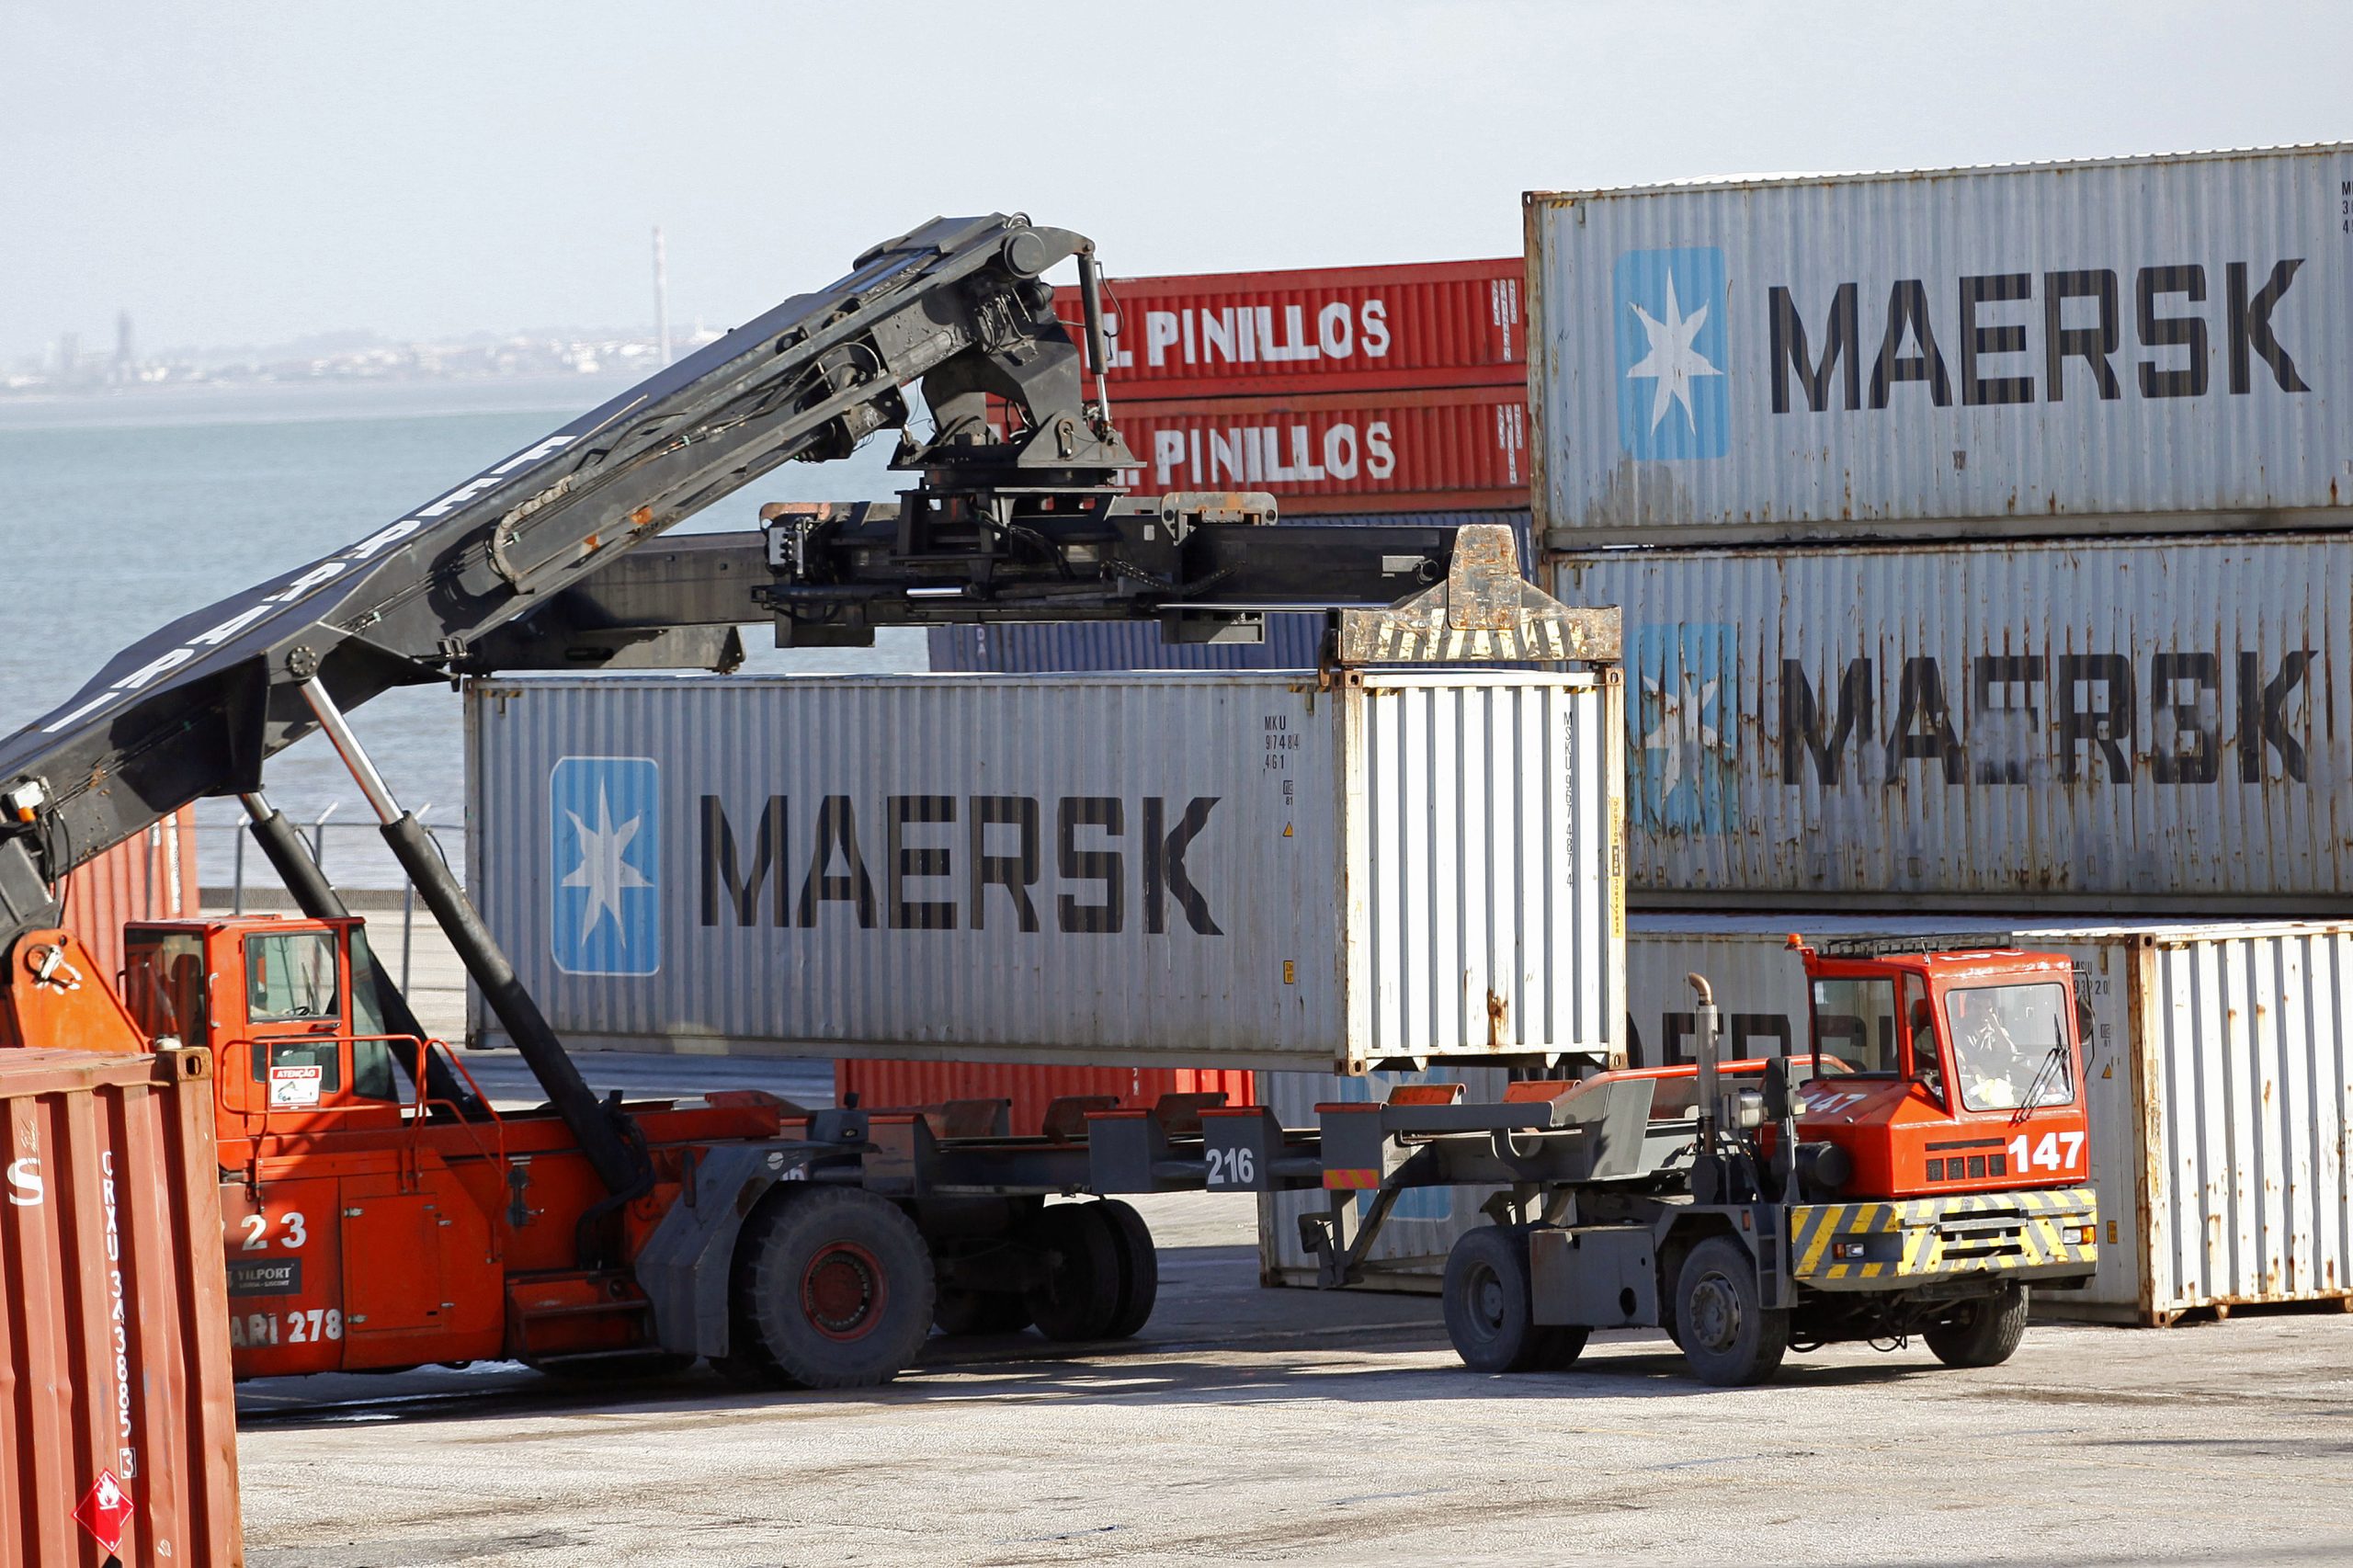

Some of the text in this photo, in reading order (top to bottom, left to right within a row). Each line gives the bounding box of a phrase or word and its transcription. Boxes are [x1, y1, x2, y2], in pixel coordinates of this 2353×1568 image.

[1146, 300, 1392, 367] PINILLOS
[1768, 257, 2311, 415] MAERSK
[1154, 421, 1396, 485] PINILLOS
[1563, 711, 1572, 770] MSKU
[1782, 650, 2320, 786] MAERSK
[700, 795, 1224, 936] MAERSK
[1206, 1147, 1255, 1185] 216
[2008, 1131, 2085, 1173] 147
[102, 1151, 119, 1261] CRXU
[239, 1267, 291, 1280] YILPORT
[110, 1270, 131, 1437] 343885
[287, 1309, 342, 1343] 278
